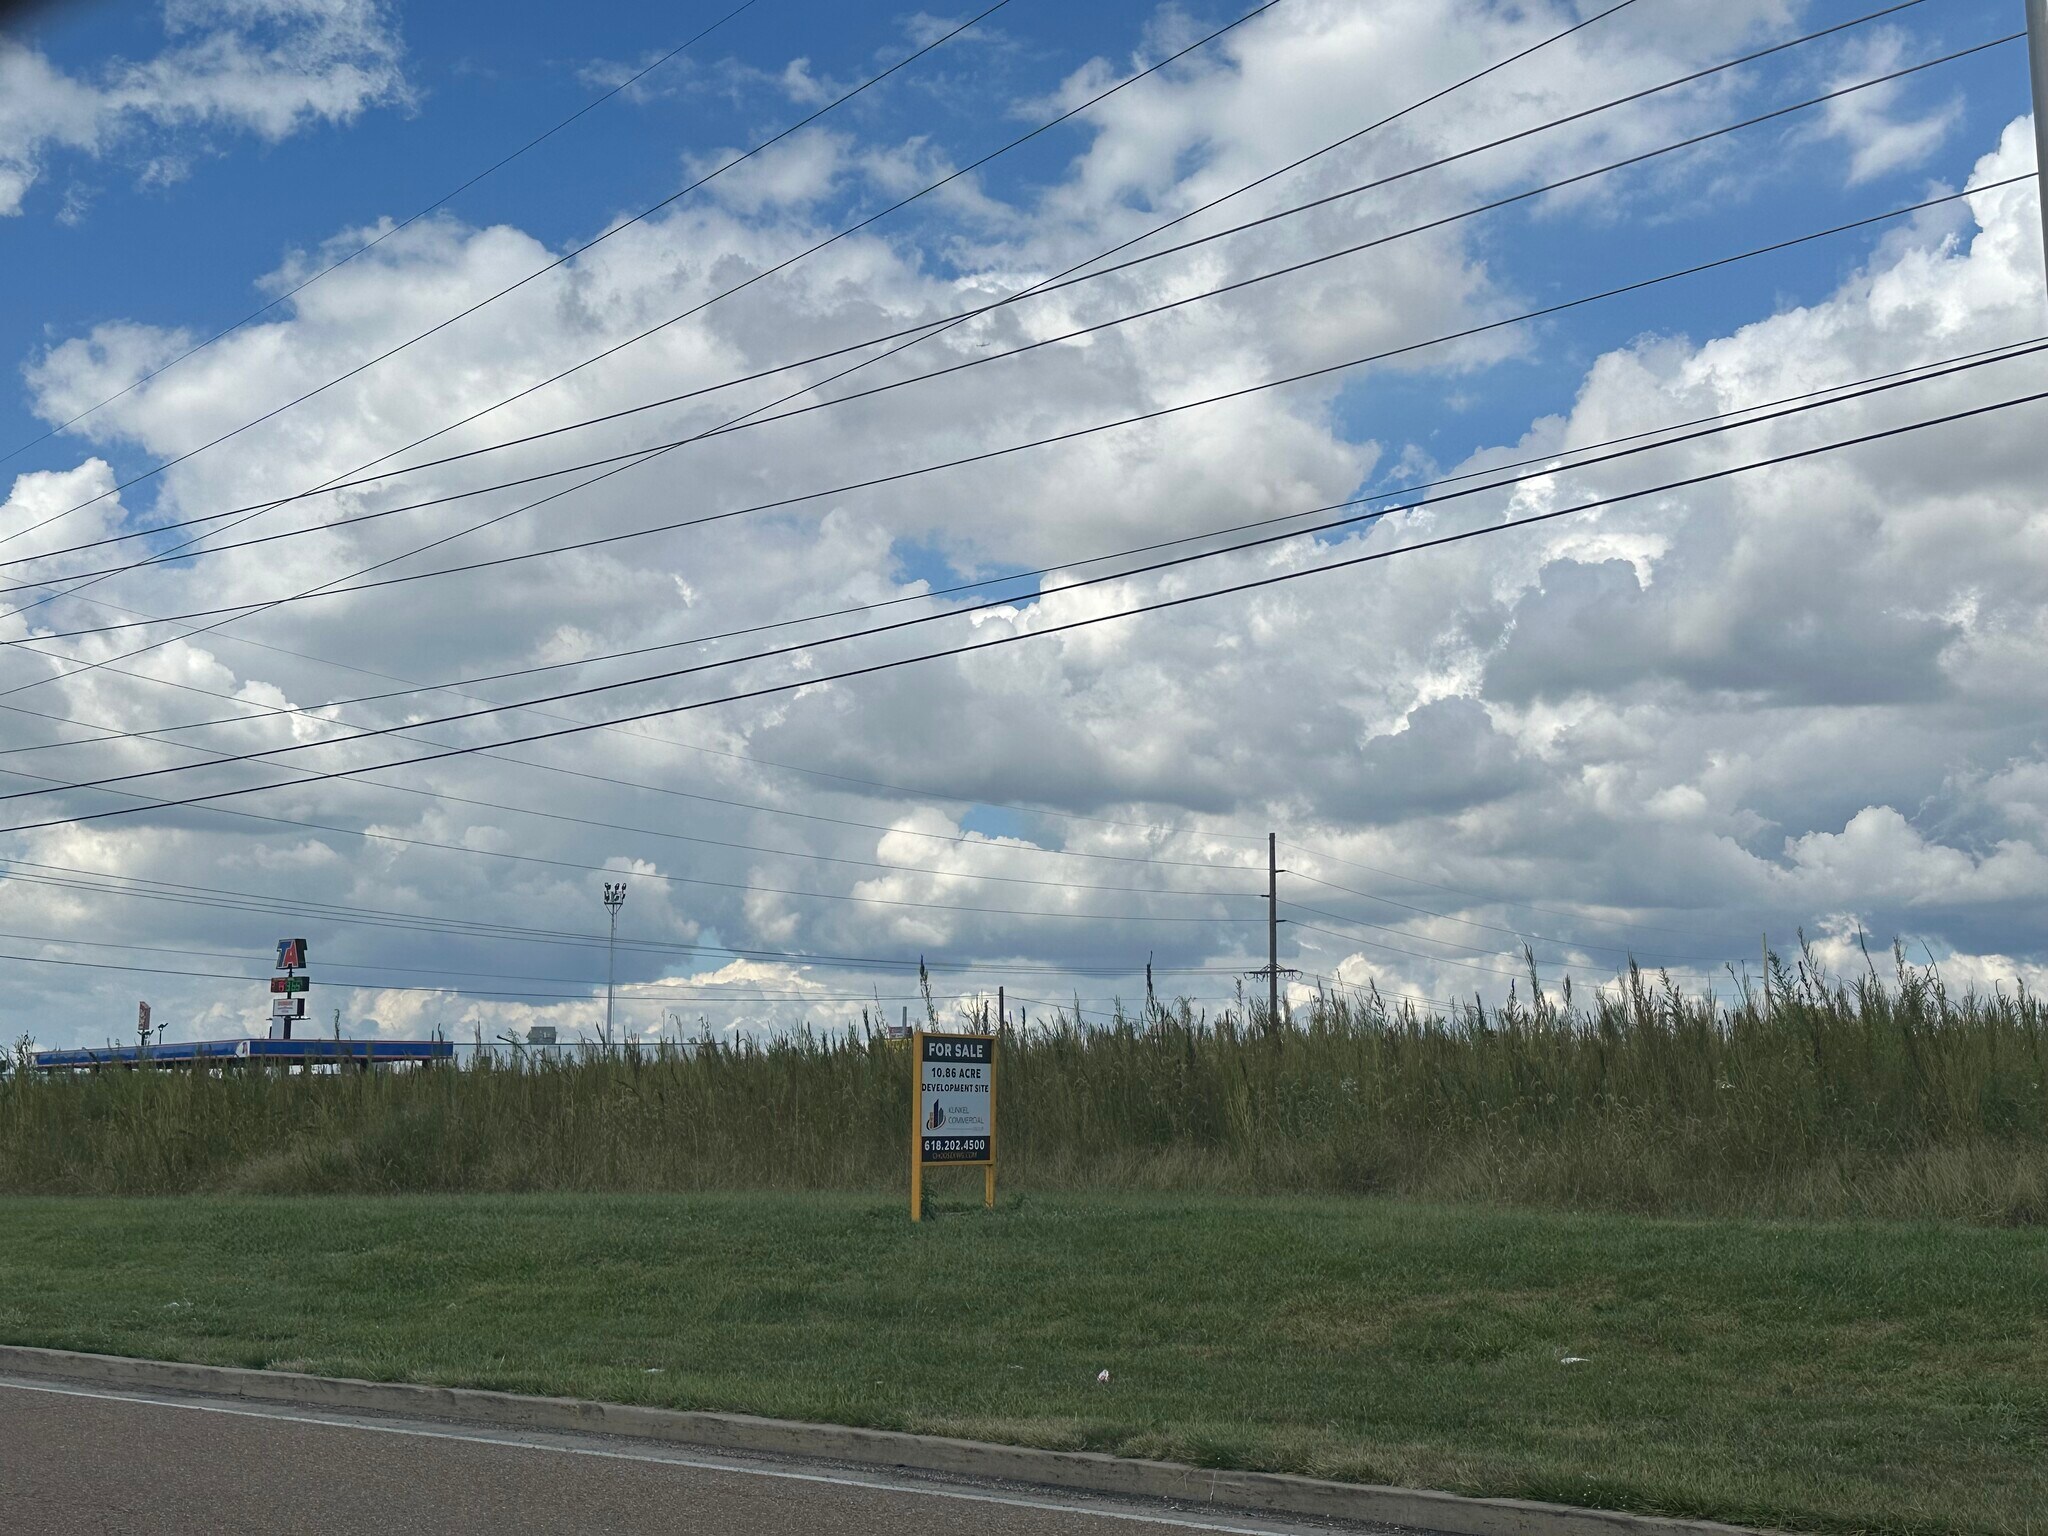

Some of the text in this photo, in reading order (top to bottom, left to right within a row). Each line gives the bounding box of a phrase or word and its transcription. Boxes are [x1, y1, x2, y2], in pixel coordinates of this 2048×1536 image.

[276, 939, 299, 969] TA
[928, 1043, 983, 1058] FOR SALE
[931, 1067, 981, 1079] 10.86 ACRE
[922, 1083, 989, 1093] DEVELOPMENT SITE
[924, 1139, 985, 1151] 618.202.4500
